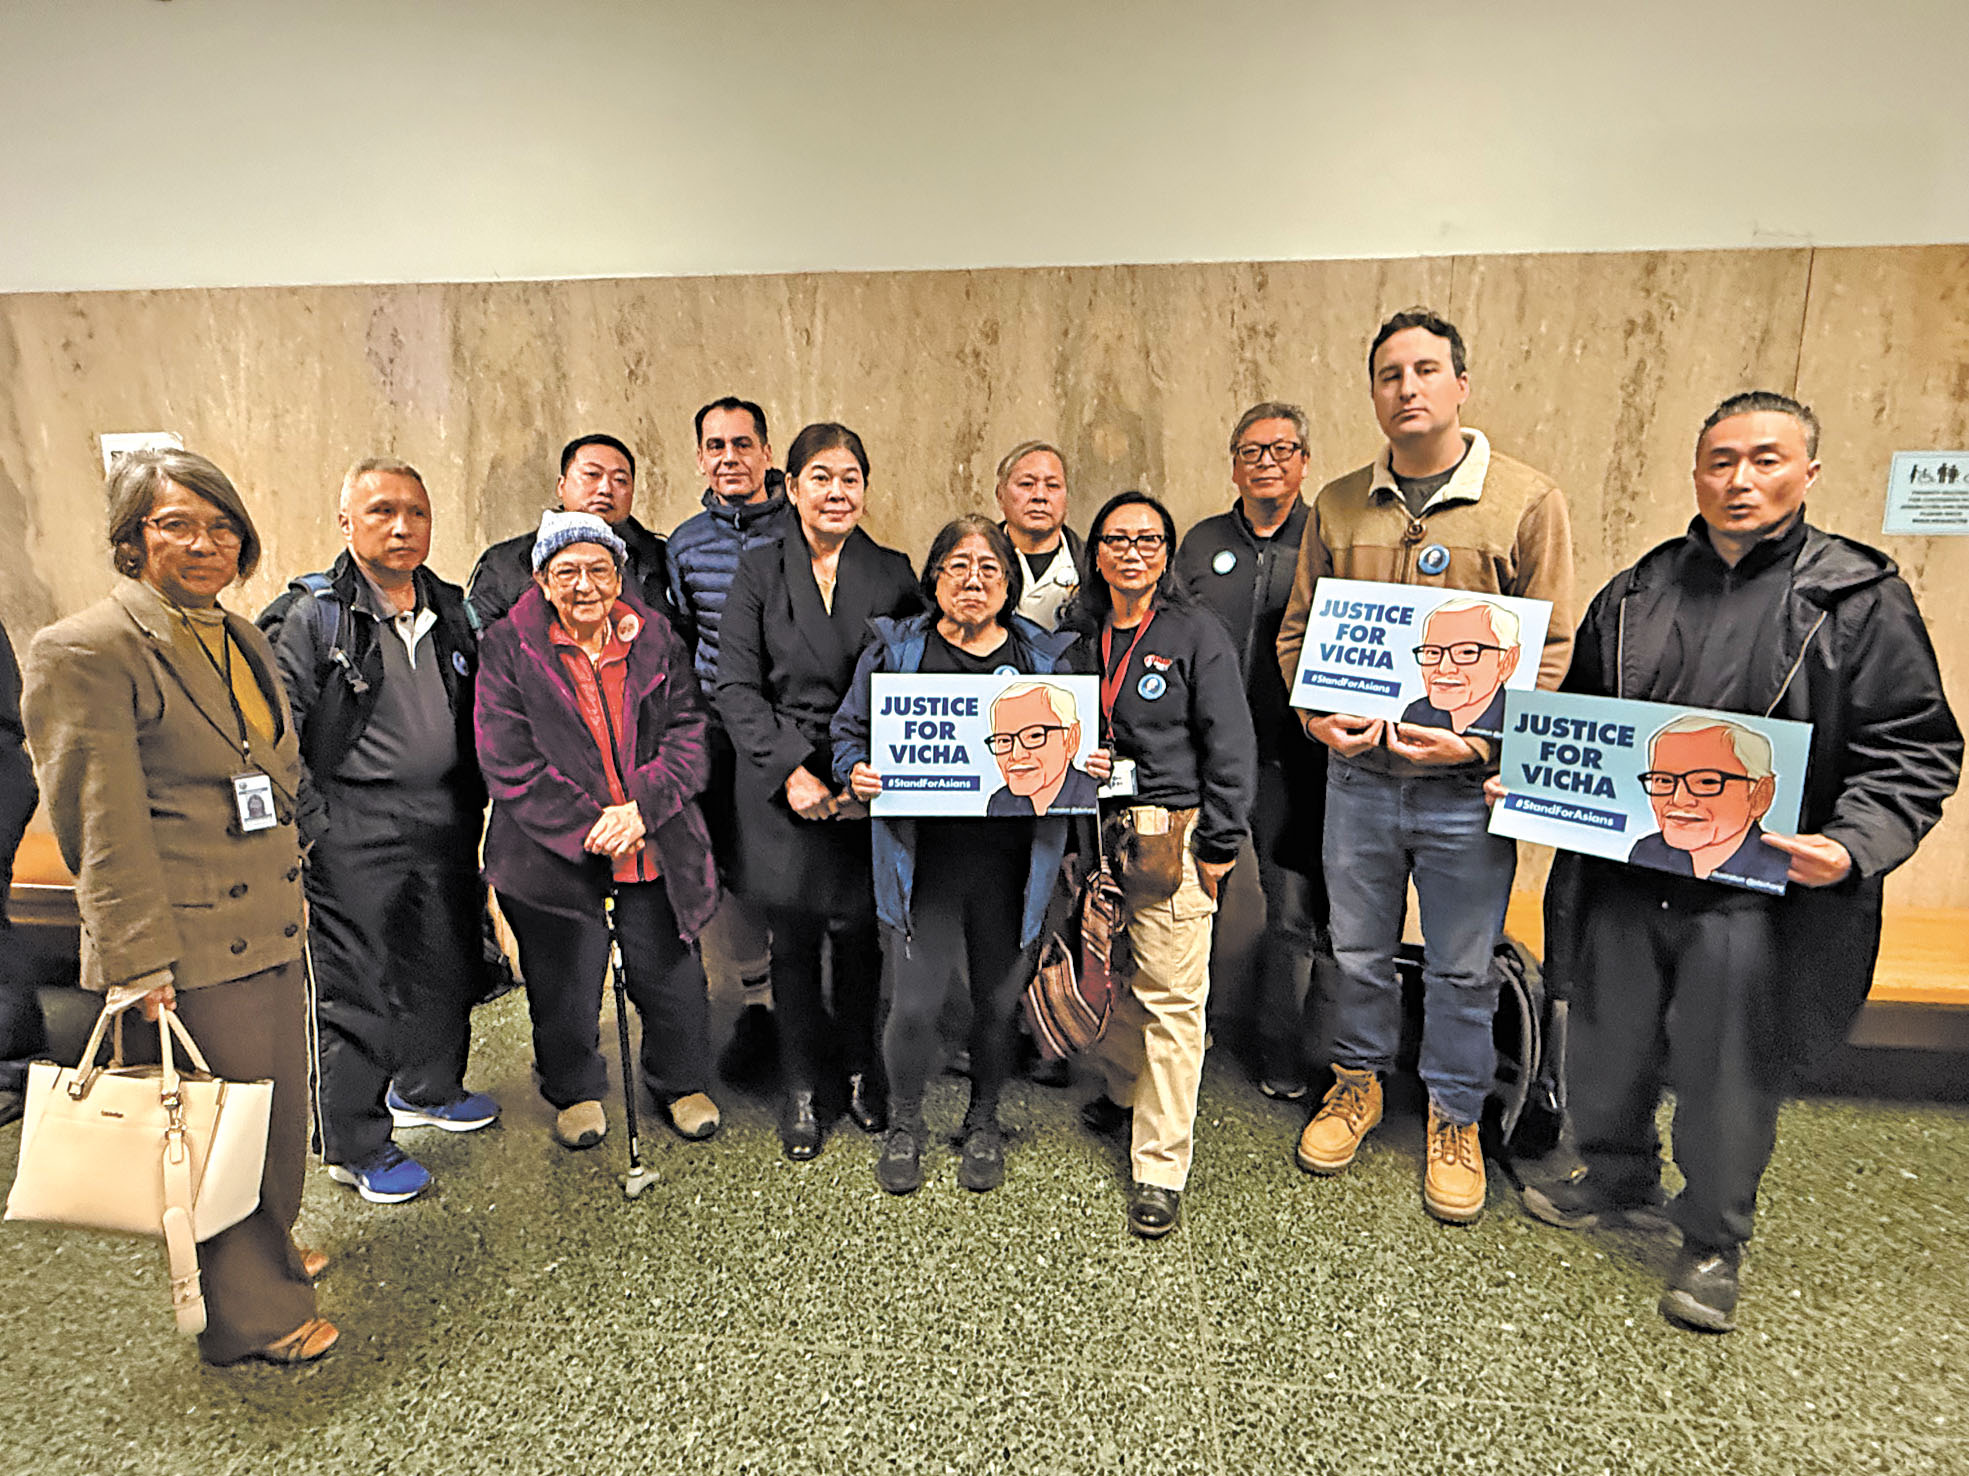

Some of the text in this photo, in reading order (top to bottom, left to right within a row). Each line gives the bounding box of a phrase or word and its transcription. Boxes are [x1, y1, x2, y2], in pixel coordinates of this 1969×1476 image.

[1319, 599, 1415, 626] JUSTICE
[1335, 623, 1387, 646] FOR
[1320, 643, 1394, 671] VICHA
[1310, 673, 1391, 694] #StandForAsians
[880, 696, 979, 717] JUSTICE
[904, 720, 957, 741] FOR
[1514, 713, 1636, 748] JUSTICE
[888, 744, 970, 765] VICHA
[1540, 741, 1603, 770] FOR
[888, 777, 971, 789] #StandForAsians
[1521, 763, 1617, 800] VICHA
[1515, 799, 1615, 827] #StandForAsians
